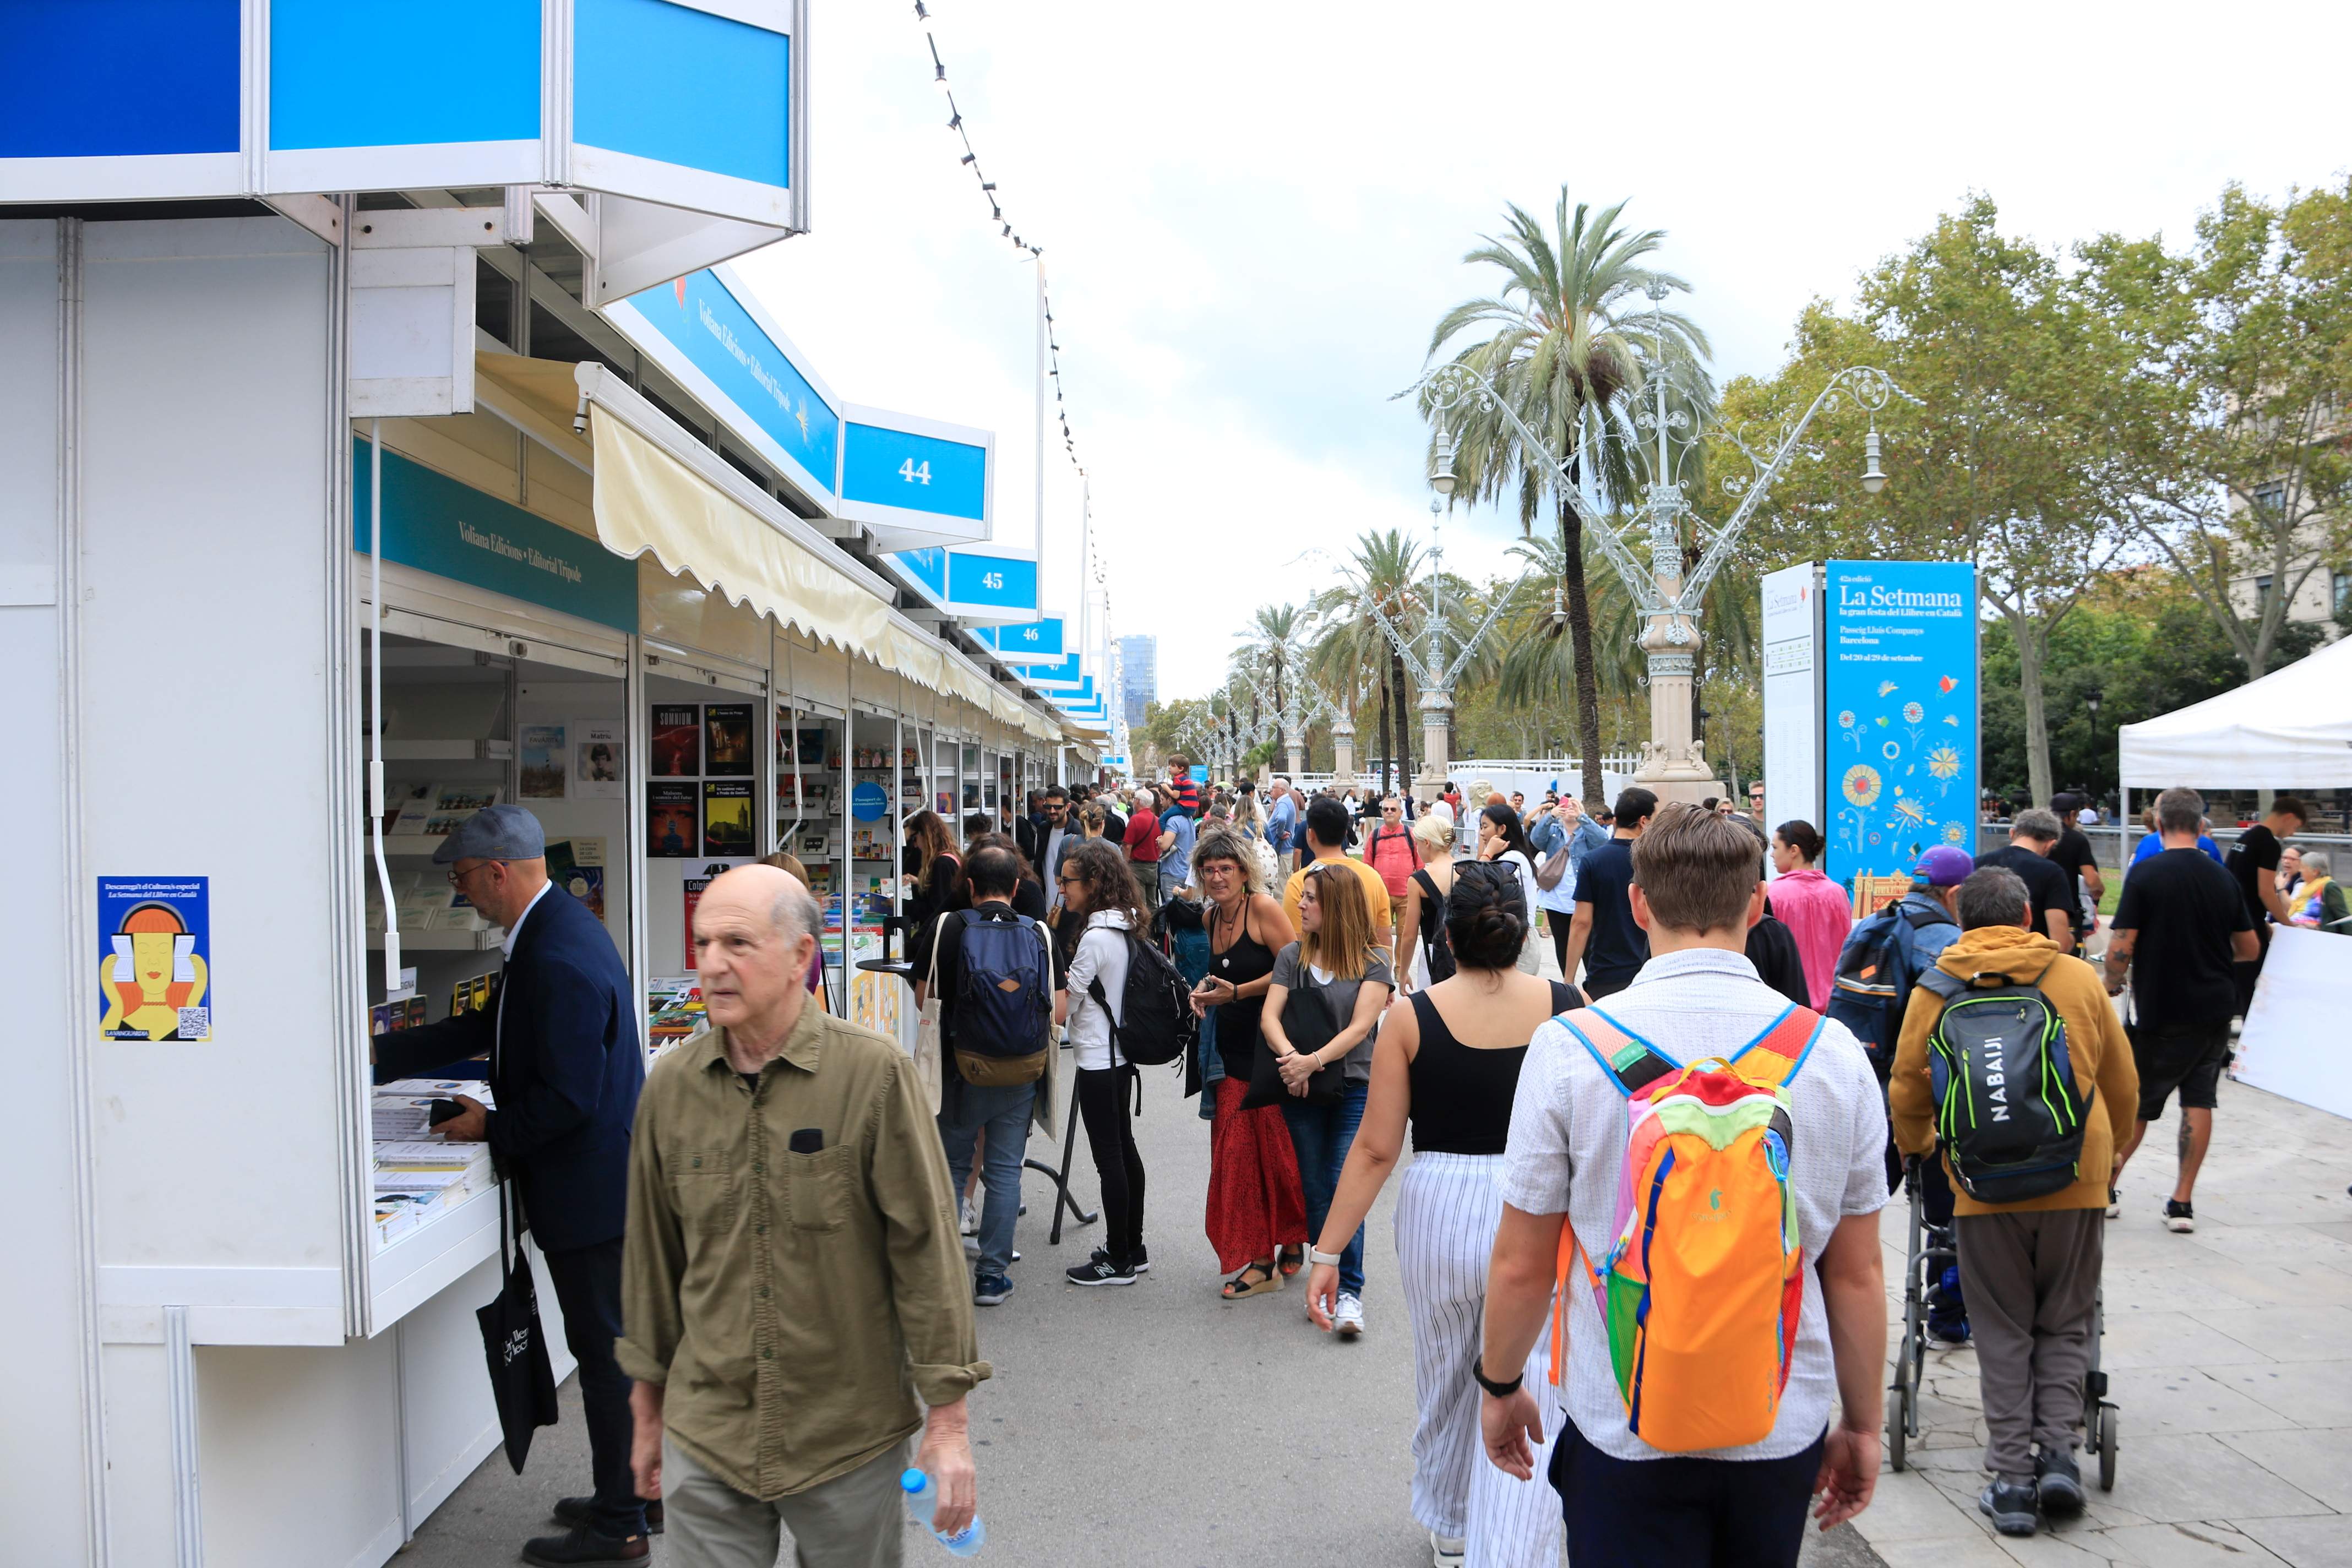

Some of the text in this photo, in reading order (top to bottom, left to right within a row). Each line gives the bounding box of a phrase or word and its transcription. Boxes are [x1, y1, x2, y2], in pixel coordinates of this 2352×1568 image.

[699, 298, 722, 341] Voliana
[722, 324, 747, 367] Edicions
[750, 355, 773, 395] Editorial
[899, 458, 931, 484] 44
[459, 520, 490, 550] Voliana
[490, 533, 523, 562] Edicions
[528, 547, 558, 574] Editorial
[982, 572, 1002, 589] 45
[1839, 585, 1962, 607] La Setmana
[1867, 608, 1886, 616] festa
[1887, 608, 1899, 616] del
[1936, 608, 1962, 617] Català
[1023, 628, 1039, 641] 46
[1839, 625, 1866, 635] Passeig
[1885, 626, 1924, 636] Companys
[1839, 635, 1880, 644] Barcelona
[1890, 654, 1923, 662] setembre
[660, 712, 692, 726] SOMNIUM
[1984, 1037, 2011, 1122] NABAIJI
